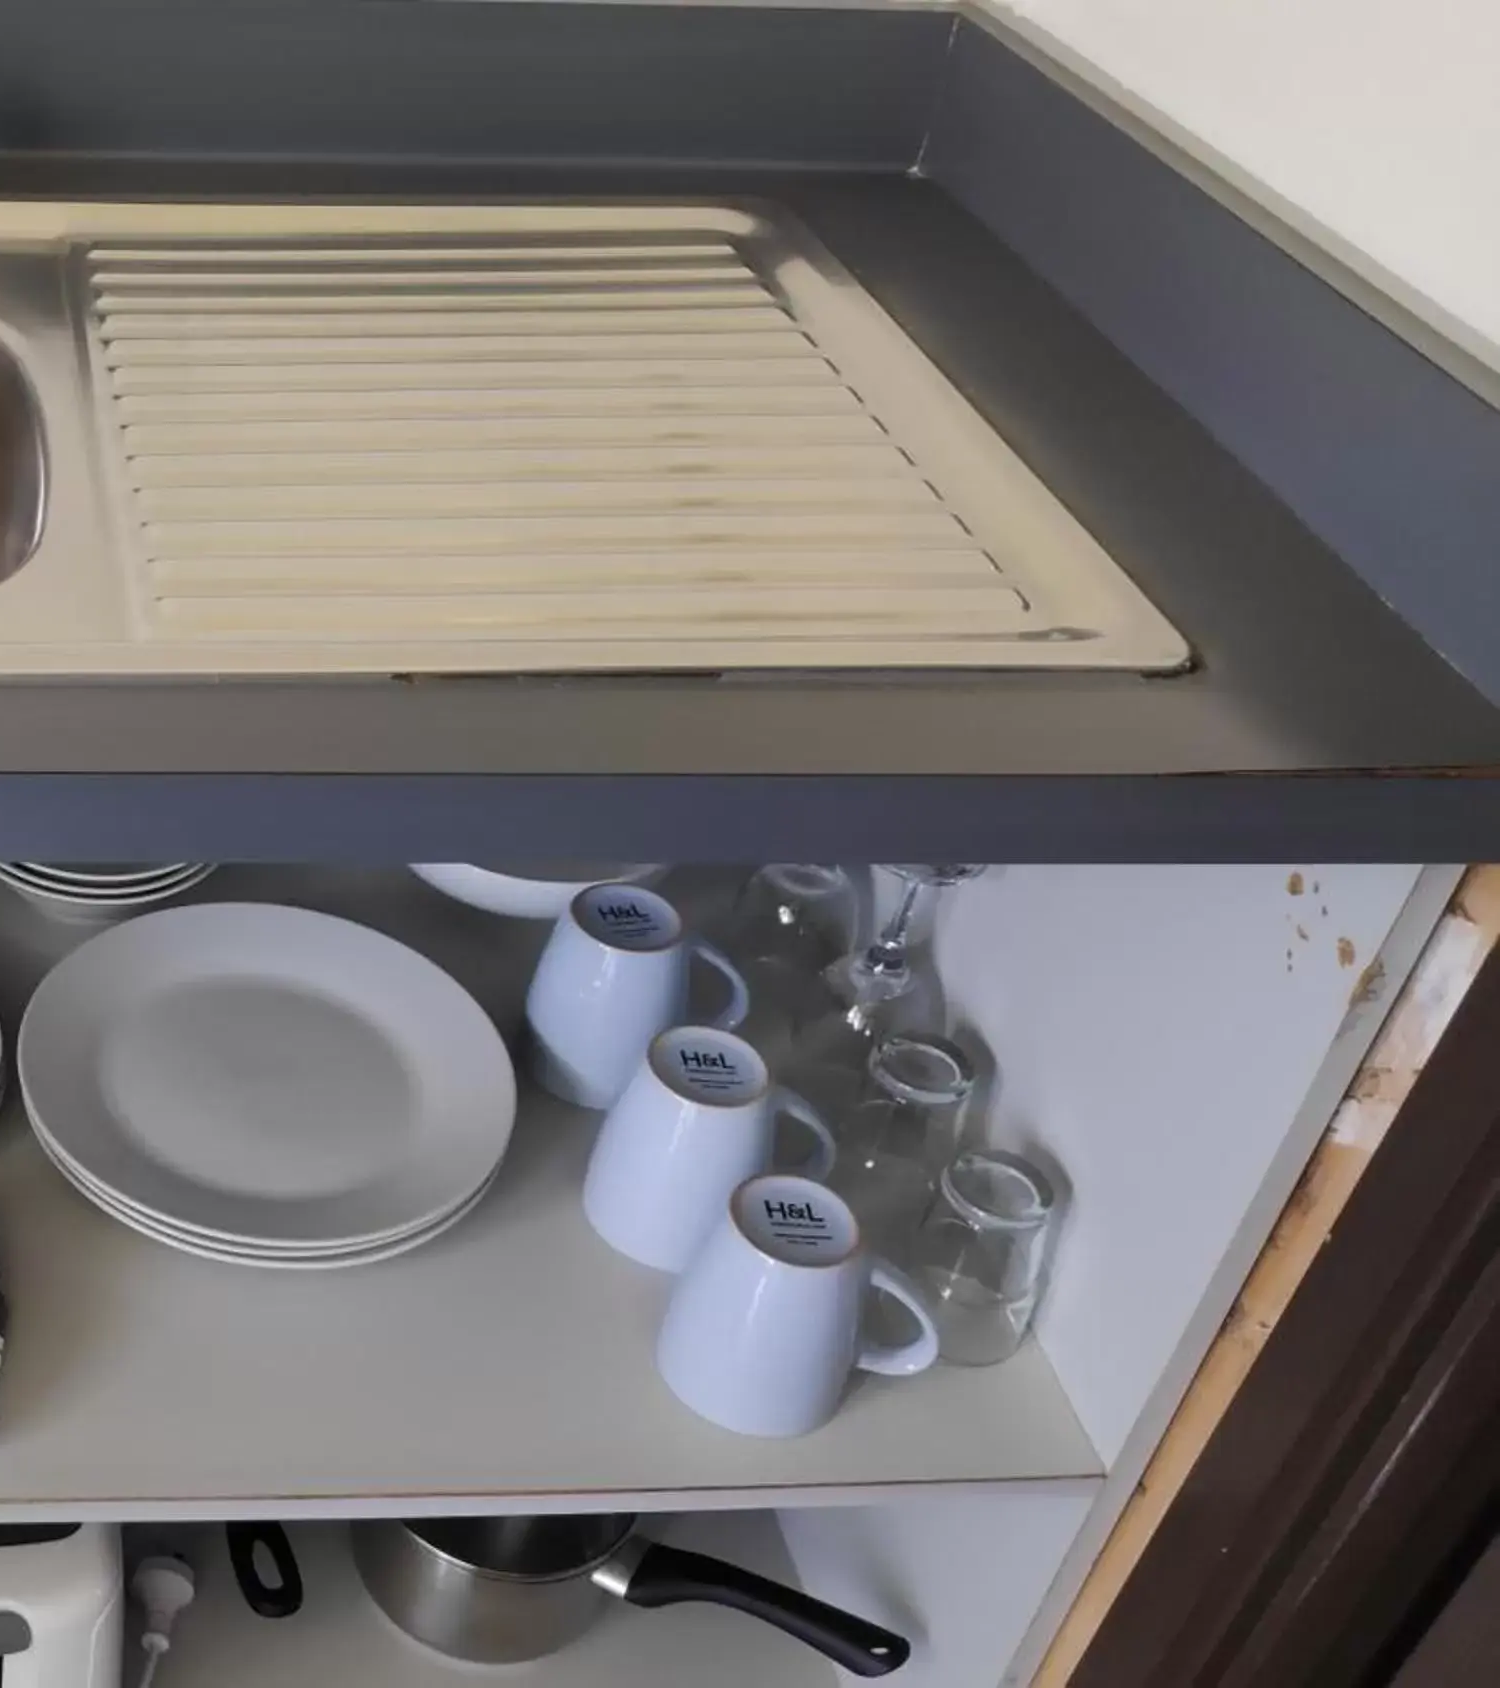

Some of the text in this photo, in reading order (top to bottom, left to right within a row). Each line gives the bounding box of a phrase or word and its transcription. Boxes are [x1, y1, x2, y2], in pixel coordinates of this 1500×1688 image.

[597, 900, 648, 921] H&L
[679, 1049, 735, 1070] H&L
[763, 1199, 826, 1223] H&L
